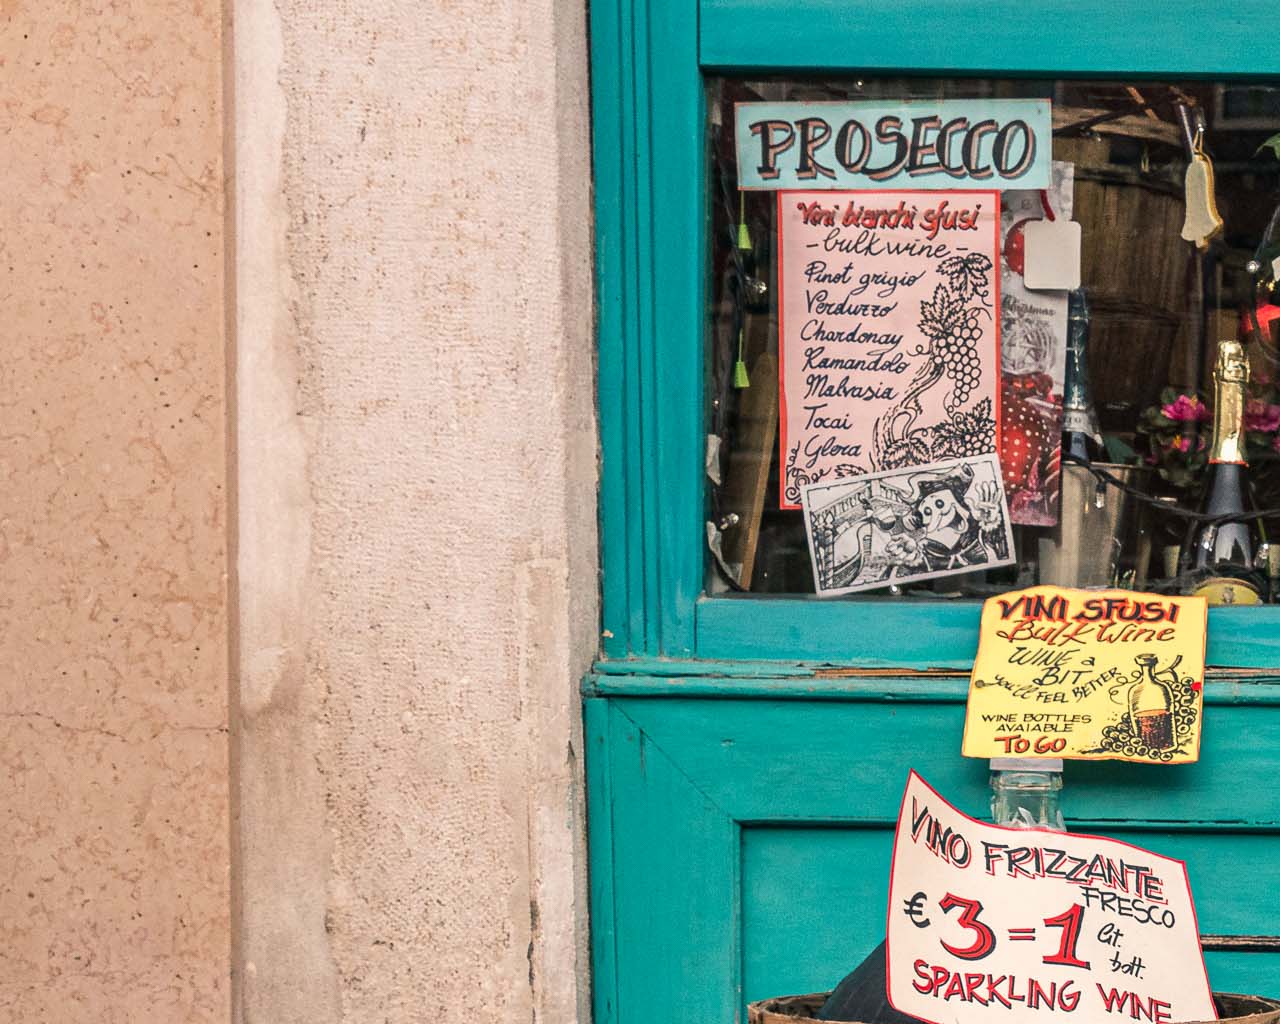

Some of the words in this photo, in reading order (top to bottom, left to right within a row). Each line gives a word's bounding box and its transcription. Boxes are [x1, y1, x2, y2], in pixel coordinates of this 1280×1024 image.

[749, 115, 1037, 182] PROSECCO
[797, 201, 839, 228] Vini
[842, 200, 918, 230] bianchi
[919, 200, 982, 241] sfusi
[823, 227, 885, 257] bulk
[882, 239, 951, 258] wine
[804, 261, 854, 286] Pinot
[850, 270, 926, 298] grigio
[803, 373, 899, 401] Malvasia
[803, 403, 853, 430] Tocai
[997, 594, 1070, 622] VINI
[1073, 598, 1181, 624] SFUSI
[996, 619, 1095, 647] Bulk
[1097, 621, 1176, 643] Wine
[1008, 647, 1080, 667] WINE
[1081, 656, 1096, 667] a
[1033, 667, 1093, 686] BIT
[1035, 691, 1070, 703] FEEL
[1073, 667, 1122, 701] BETTER
[982, 713, 1018, 723] WINE
[1023, 713, 1092, 724] BOTTLES
[994, 734, 1030, 754] TO
[1034, 735, 1067, 754] GO
[911, 796, 971, 868] VINO
[981, 841, 1168, 905] FRIZZANTE
[1079, 886, 1175, 928] FRESCO
[912, 958, 1081, 1012] SPARKLING
[1096, 983, 1172, 1024] WINE
